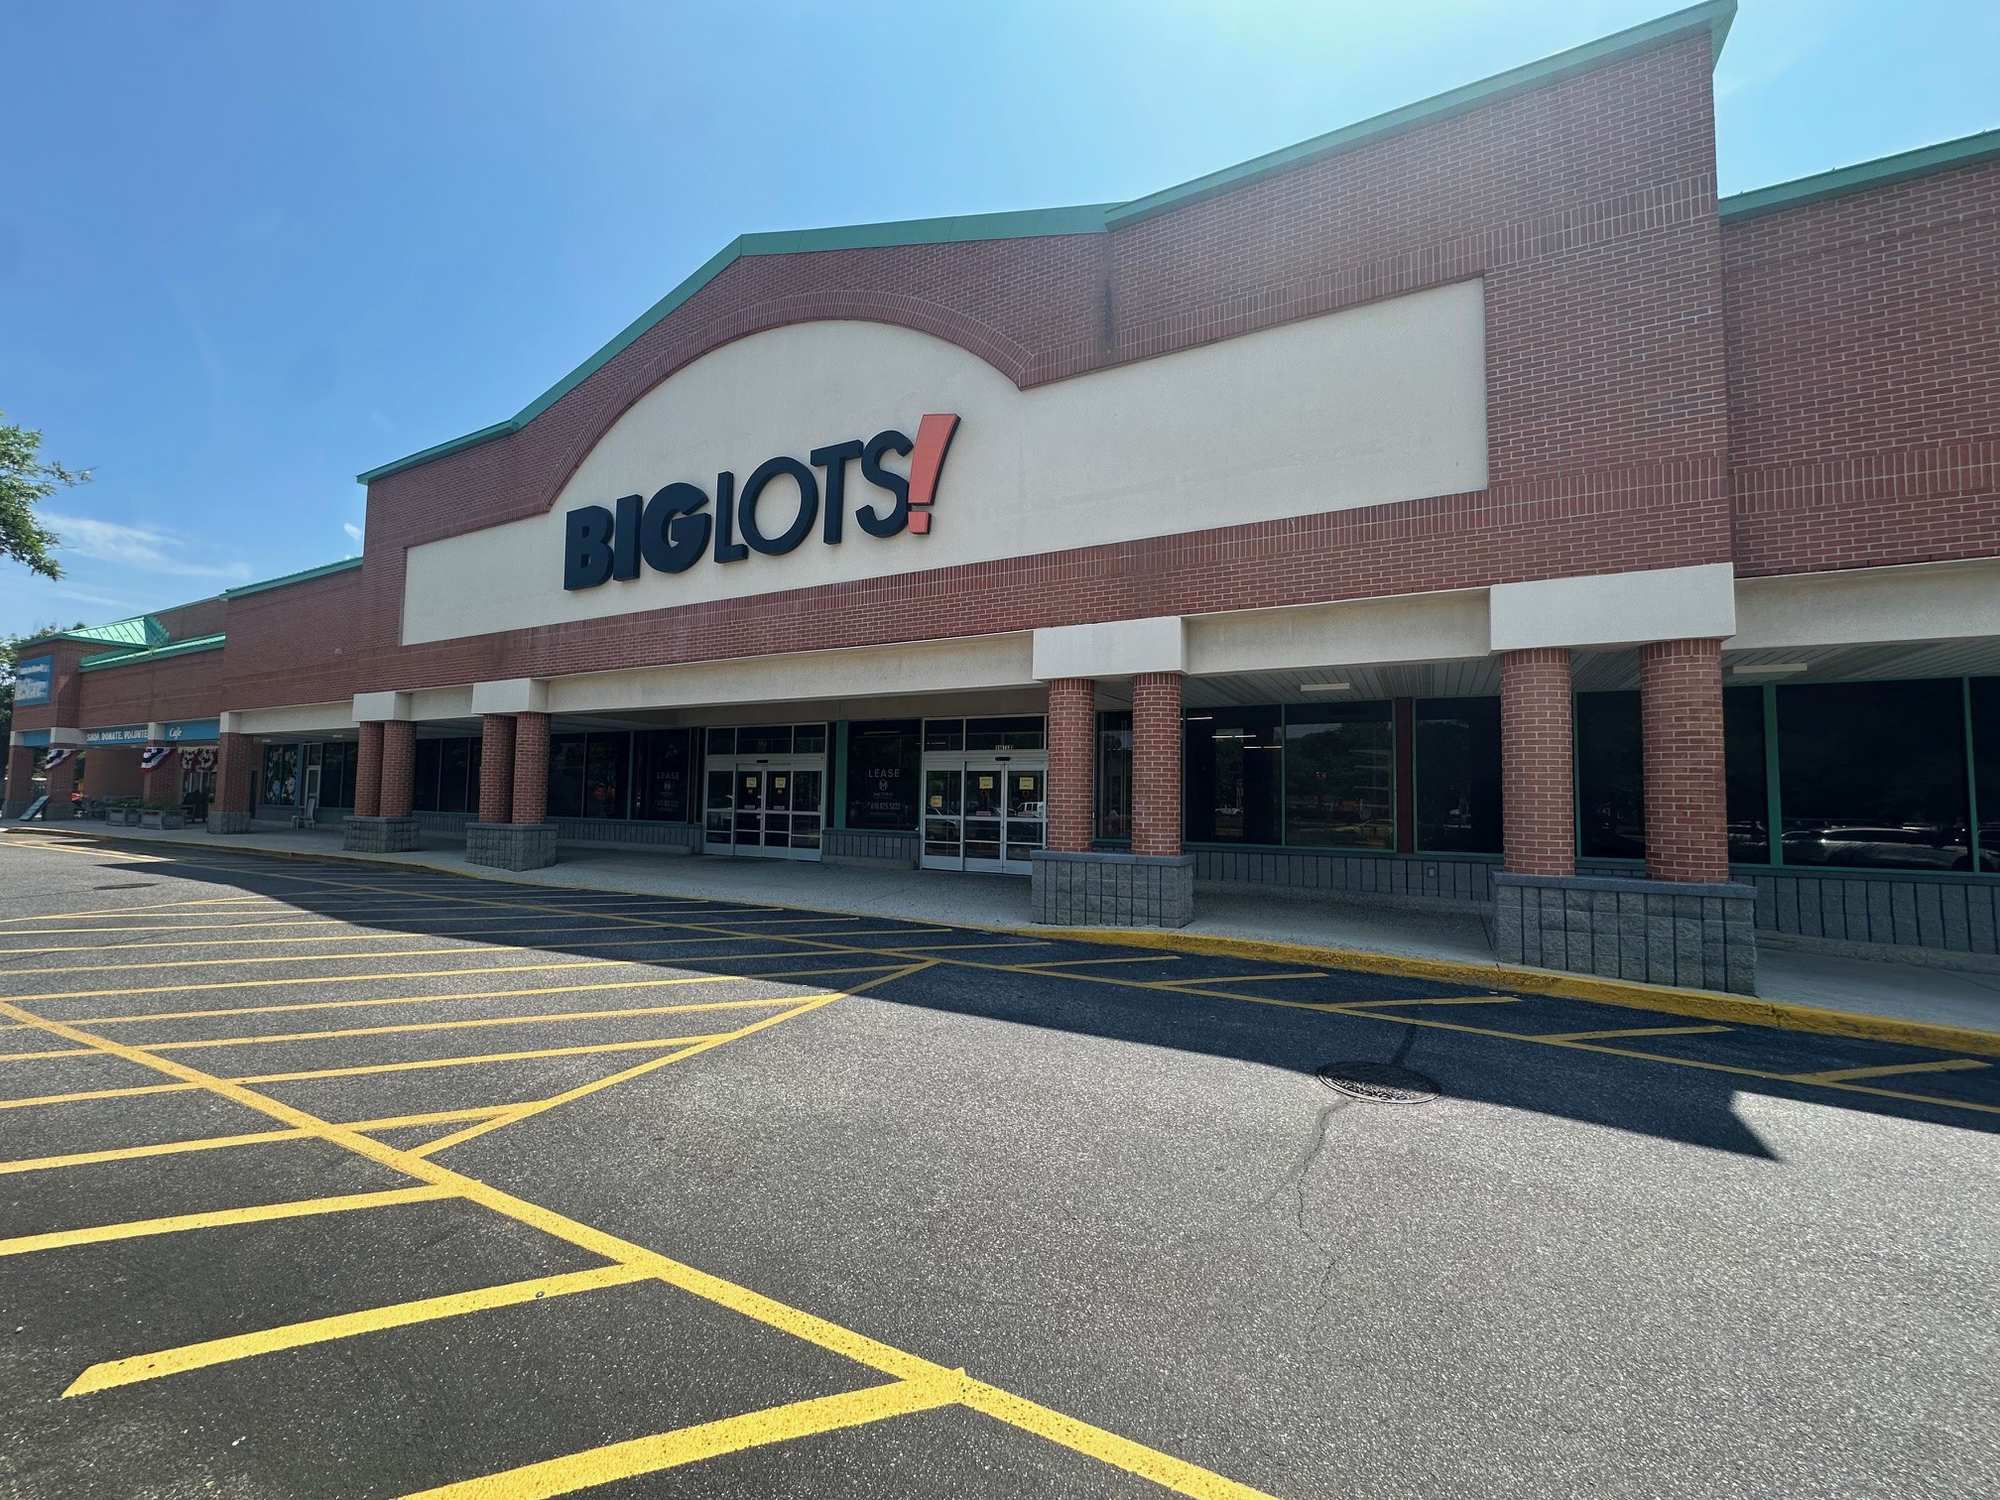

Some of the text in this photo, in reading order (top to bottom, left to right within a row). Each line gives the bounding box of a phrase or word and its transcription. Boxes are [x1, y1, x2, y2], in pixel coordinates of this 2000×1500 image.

[563, 413, 962, 591] BIG LOTS!
[868, 768, 901, 778] LEASE
